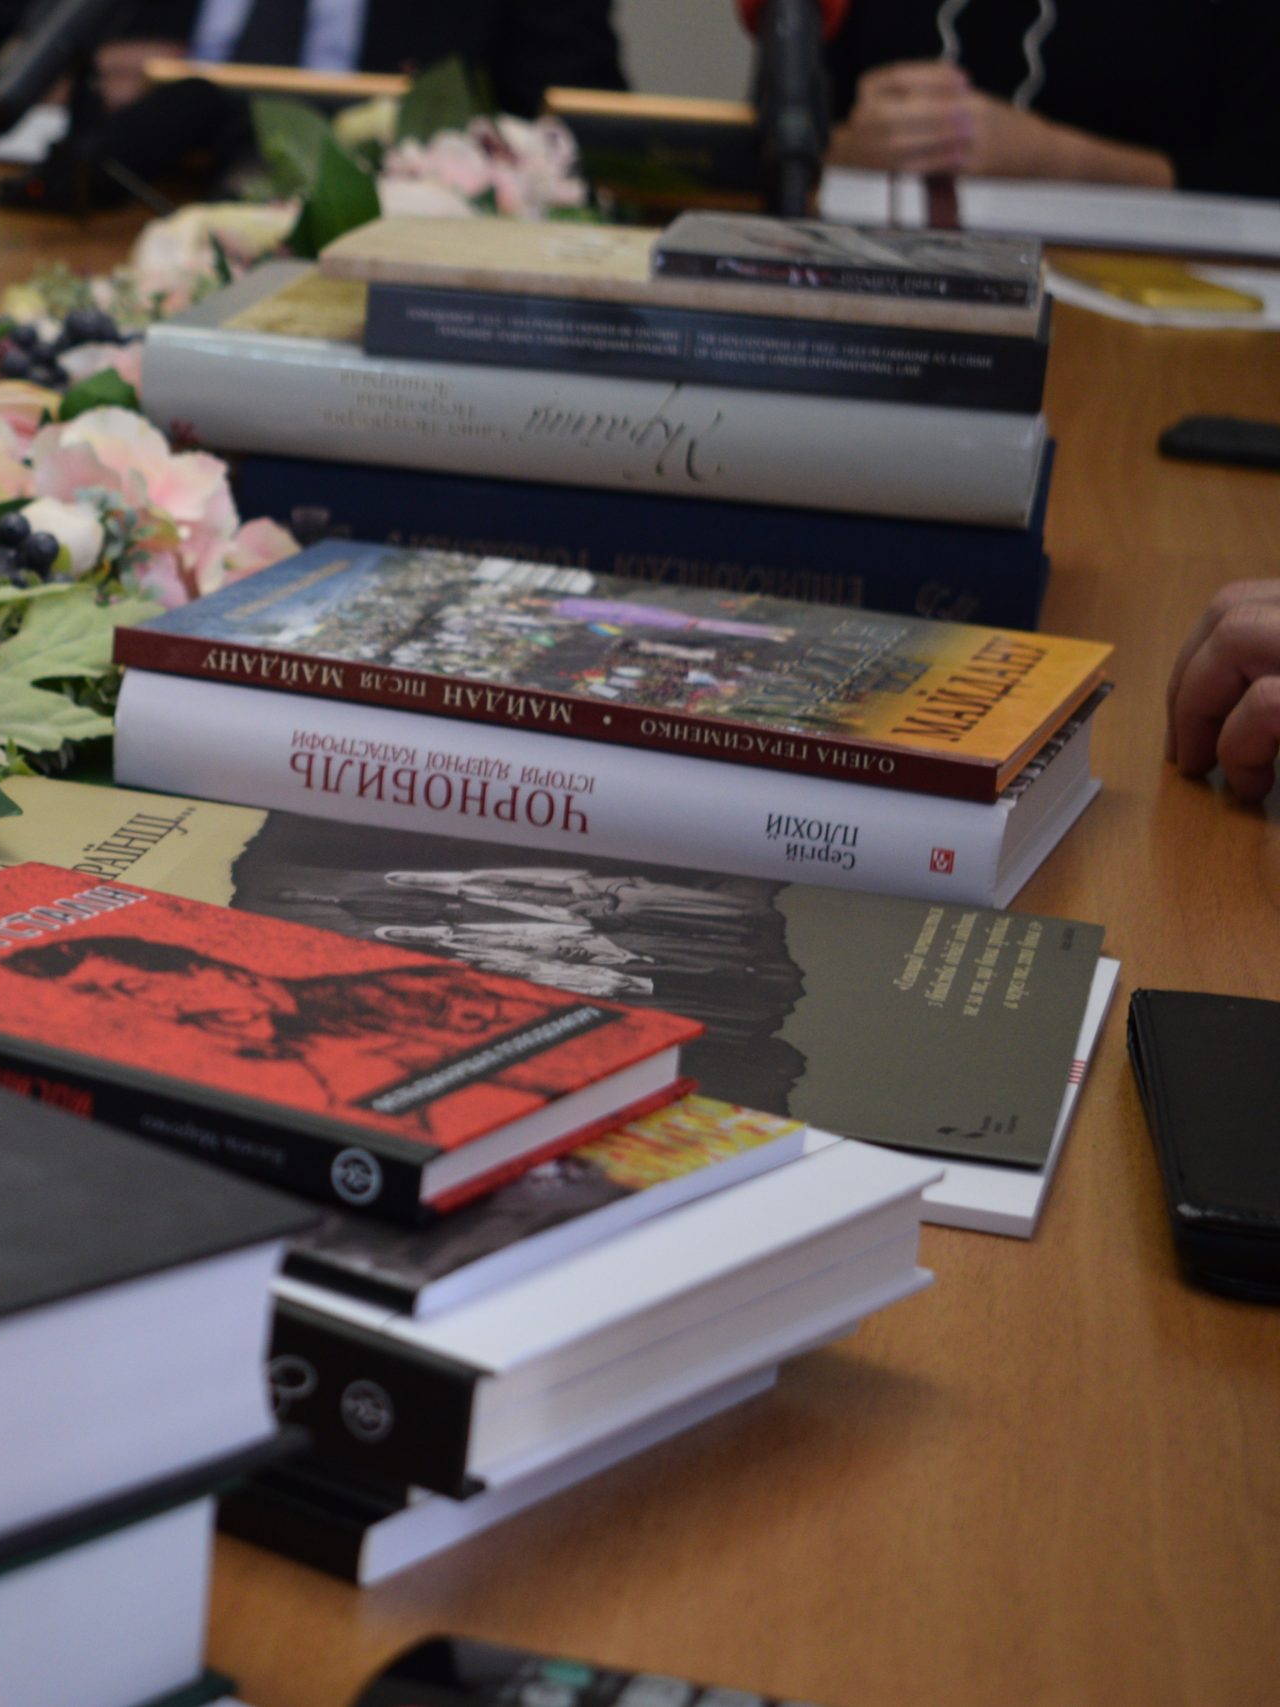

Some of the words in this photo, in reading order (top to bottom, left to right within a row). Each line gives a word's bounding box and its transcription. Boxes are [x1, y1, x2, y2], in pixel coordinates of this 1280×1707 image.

[201, 649, 345, 688] МАЙДАНУ
[443, 685, 573, 724] МАЙДАН
[291, 730, 417, 765] КАТАСТРОФИ
[640, 718, 810, 762] ГЕРАСИМЕНКО
[425, 751, 511, 780] ЯДЕРНОЇ
[818, 746, 895, 774] ОЛЕНА
[289, 752, 589, 834] ЧОРНОБИЛЬ
[521, 766, 595, 794] ІСТОРІЯ
[765, 813, 859, 848] ПЛОХІЙ
[785, 841, 856, 870] Сергій
